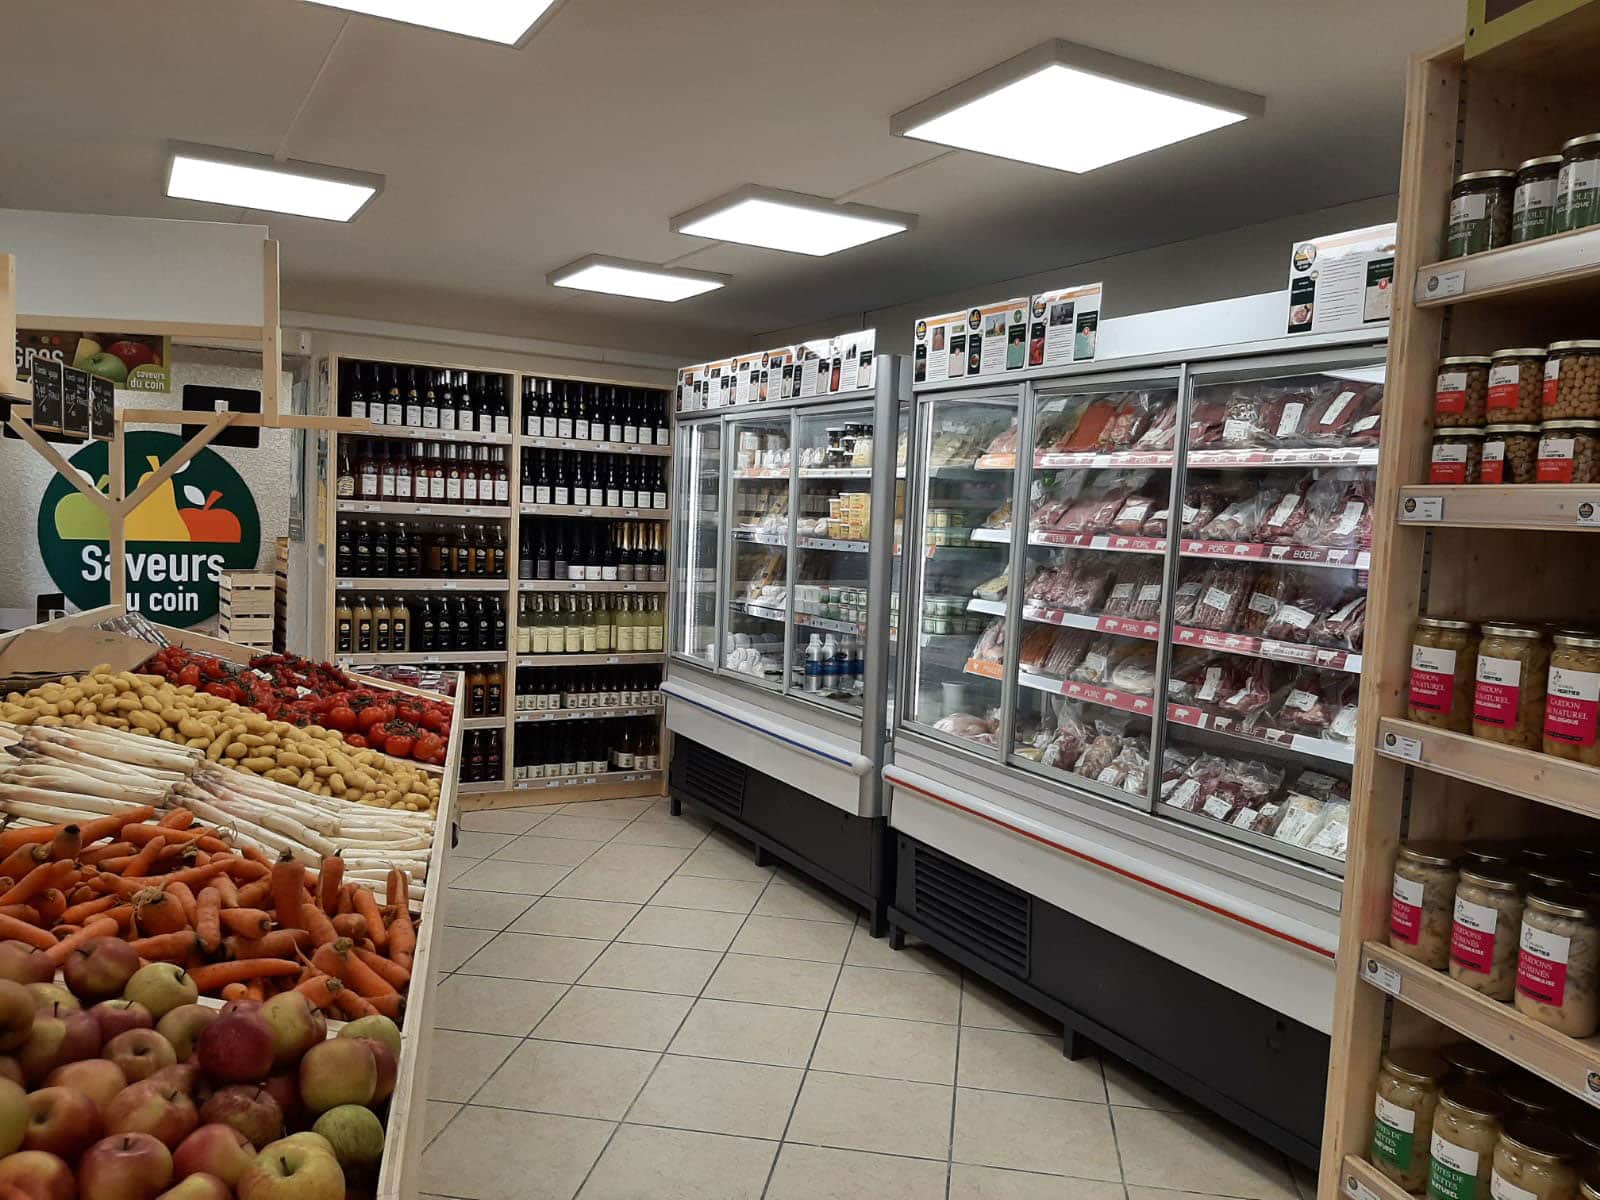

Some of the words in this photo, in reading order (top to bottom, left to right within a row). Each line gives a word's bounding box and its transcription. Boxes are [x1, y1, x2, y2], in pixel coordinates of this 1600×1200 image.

[130, 377, 142, 388] du
[144, 380, 165, 390] coin
[1207, 543, 1228, 553] PORC
[1293, 550, 1321, 560] BOEUF
[149, 585, 199, 612] coin
